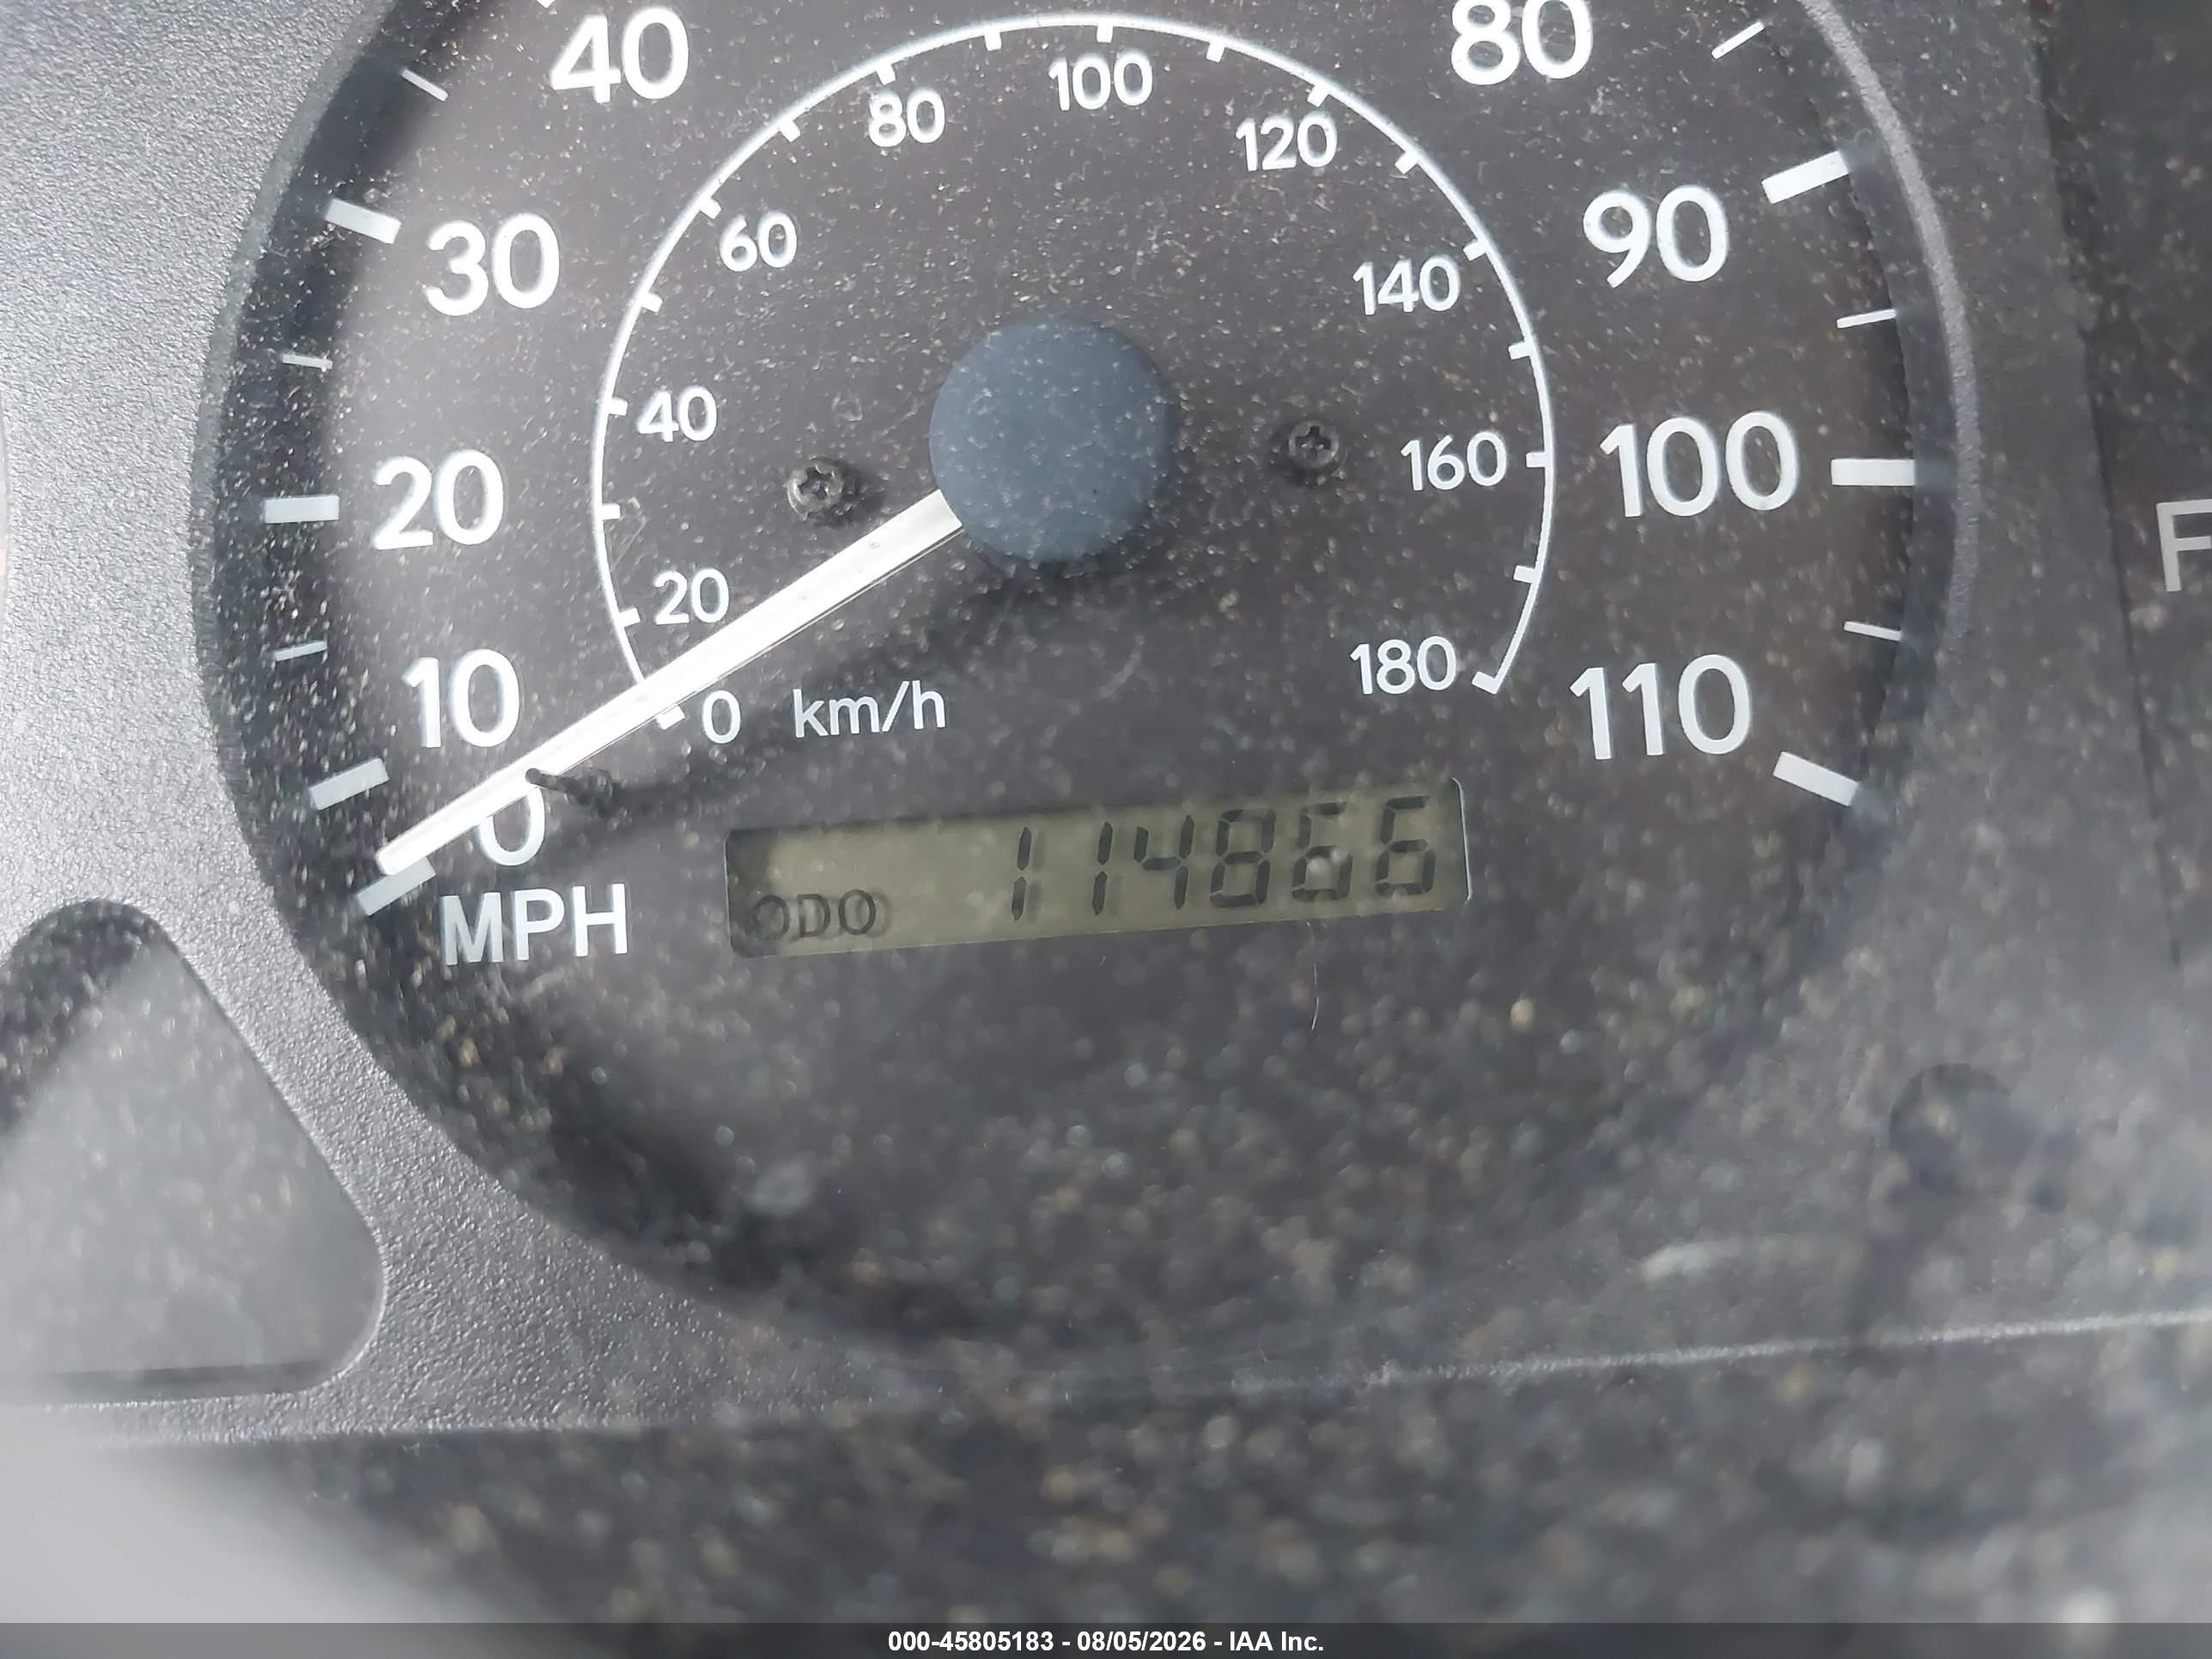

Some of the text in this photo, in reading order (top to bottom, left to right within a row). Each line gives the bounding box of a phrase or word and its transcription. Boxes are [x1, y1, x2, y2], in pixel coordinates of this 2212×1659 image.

[550, 7, 690, 103] 40
[1450, 0, 1594, 85] 80
[1048, 52, 1154, 112] 100
[867, 88, 945, 148] 80
[1235, 112, 1338, 172] 120
[424, 212, 561, 316] 30
[719, 211, 799, 272] 60
[1582, 184, 1729, 289] 90
[1352, 256, 1462, 315] 140
[635, 385, 719, 444] 40
[1400, 431, 1509, 492] 160
[1599, 410, 1802, 519] 100
[372, 448, 505, 550] 20
[653, 568, 730, 625] 20
[1350, 635, 1458, 696] 180
[402, 649, 520, 749] 10
[701, 690, 742, 744] 0
[793, 681, 946, 738] km/h
[1570, 654, 1753, 762] 110
[1011, 795, 1437, 921] 114866
[440, 883, 628, 966] MPH
[753, 888, 879, 940] ODO
